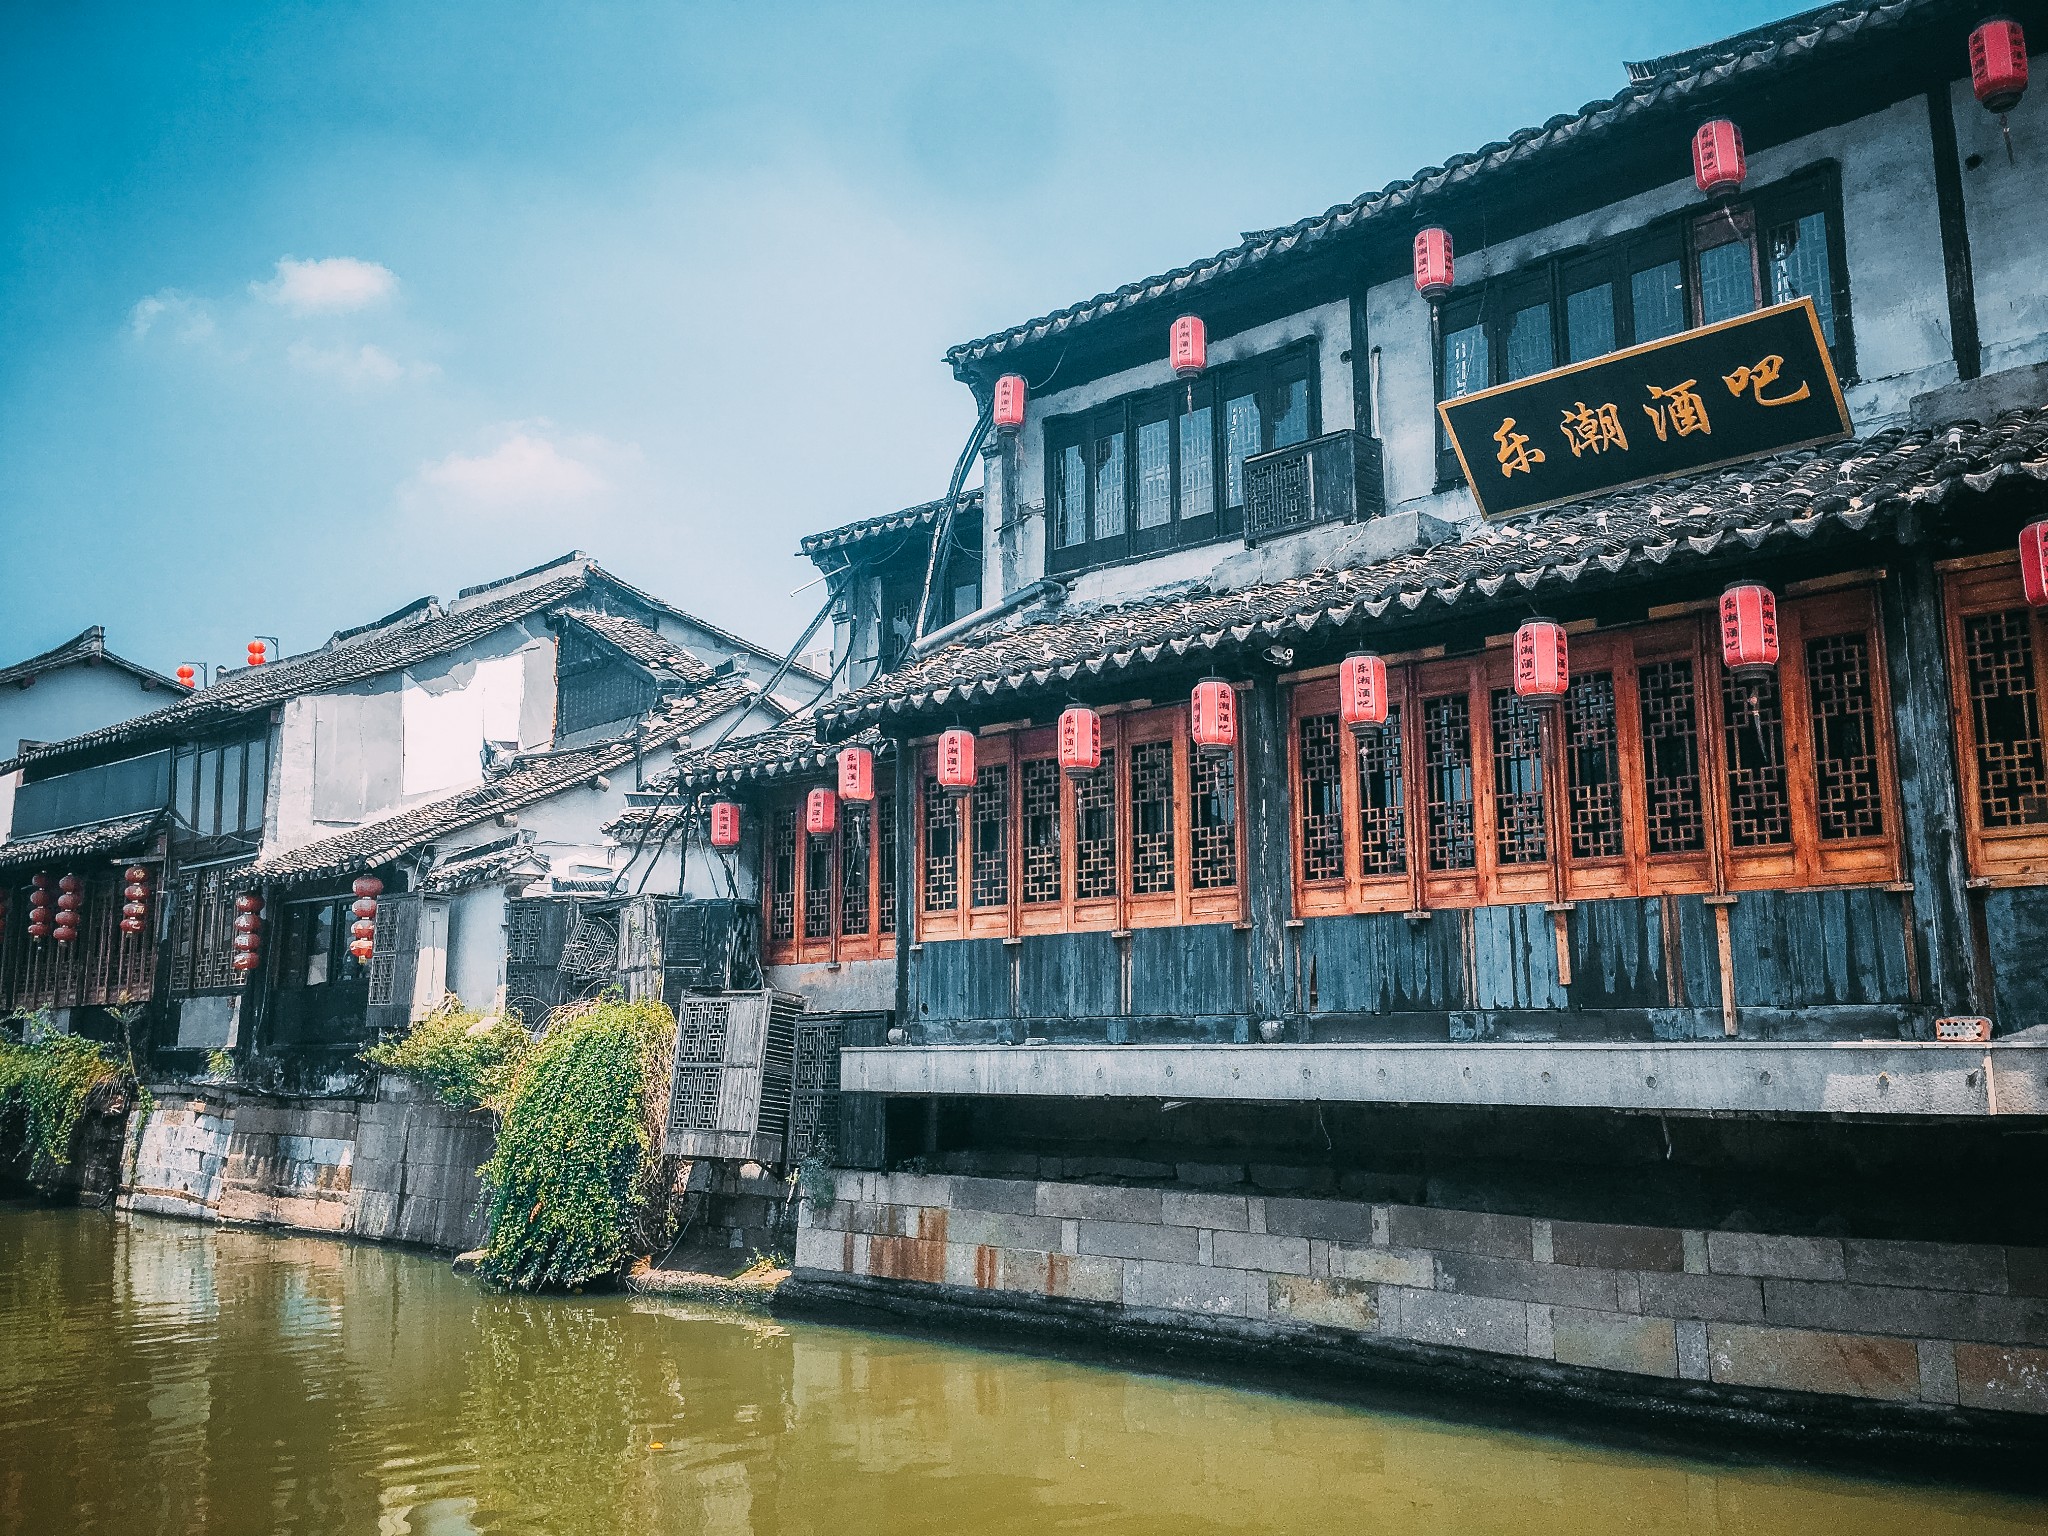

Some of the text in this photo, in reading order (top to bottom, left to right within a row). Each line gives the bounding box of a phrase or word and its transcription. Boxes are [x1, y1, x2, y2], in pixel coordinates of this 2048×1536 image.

[1417, 237, 1429, 274] 乐潮酒吧
[1179, 321, 1190, 355] 乐潮酒吧
[1493, 354, 1811, 480] 乐潮酒吧
[1724, 597, 1739, 650] 乐潮酒吧
[1762, 594, 1777, 649] 乐潮酒吧
[1520, 631, 1535, 680] 乐潮酒吧
[1357, 663, 1373, 708] 乐潮酒吧
[1218, 690, 1231, 732] 乐潮酒吧
[947, 736, 959, 774] 乐潮酒吧
[1064, 715, 1075, 756] 乐潮酒吧
[846, 753, 857, 788] 乐潮酒吧
[719, 808, 728, 837] 乐潮酒吧
